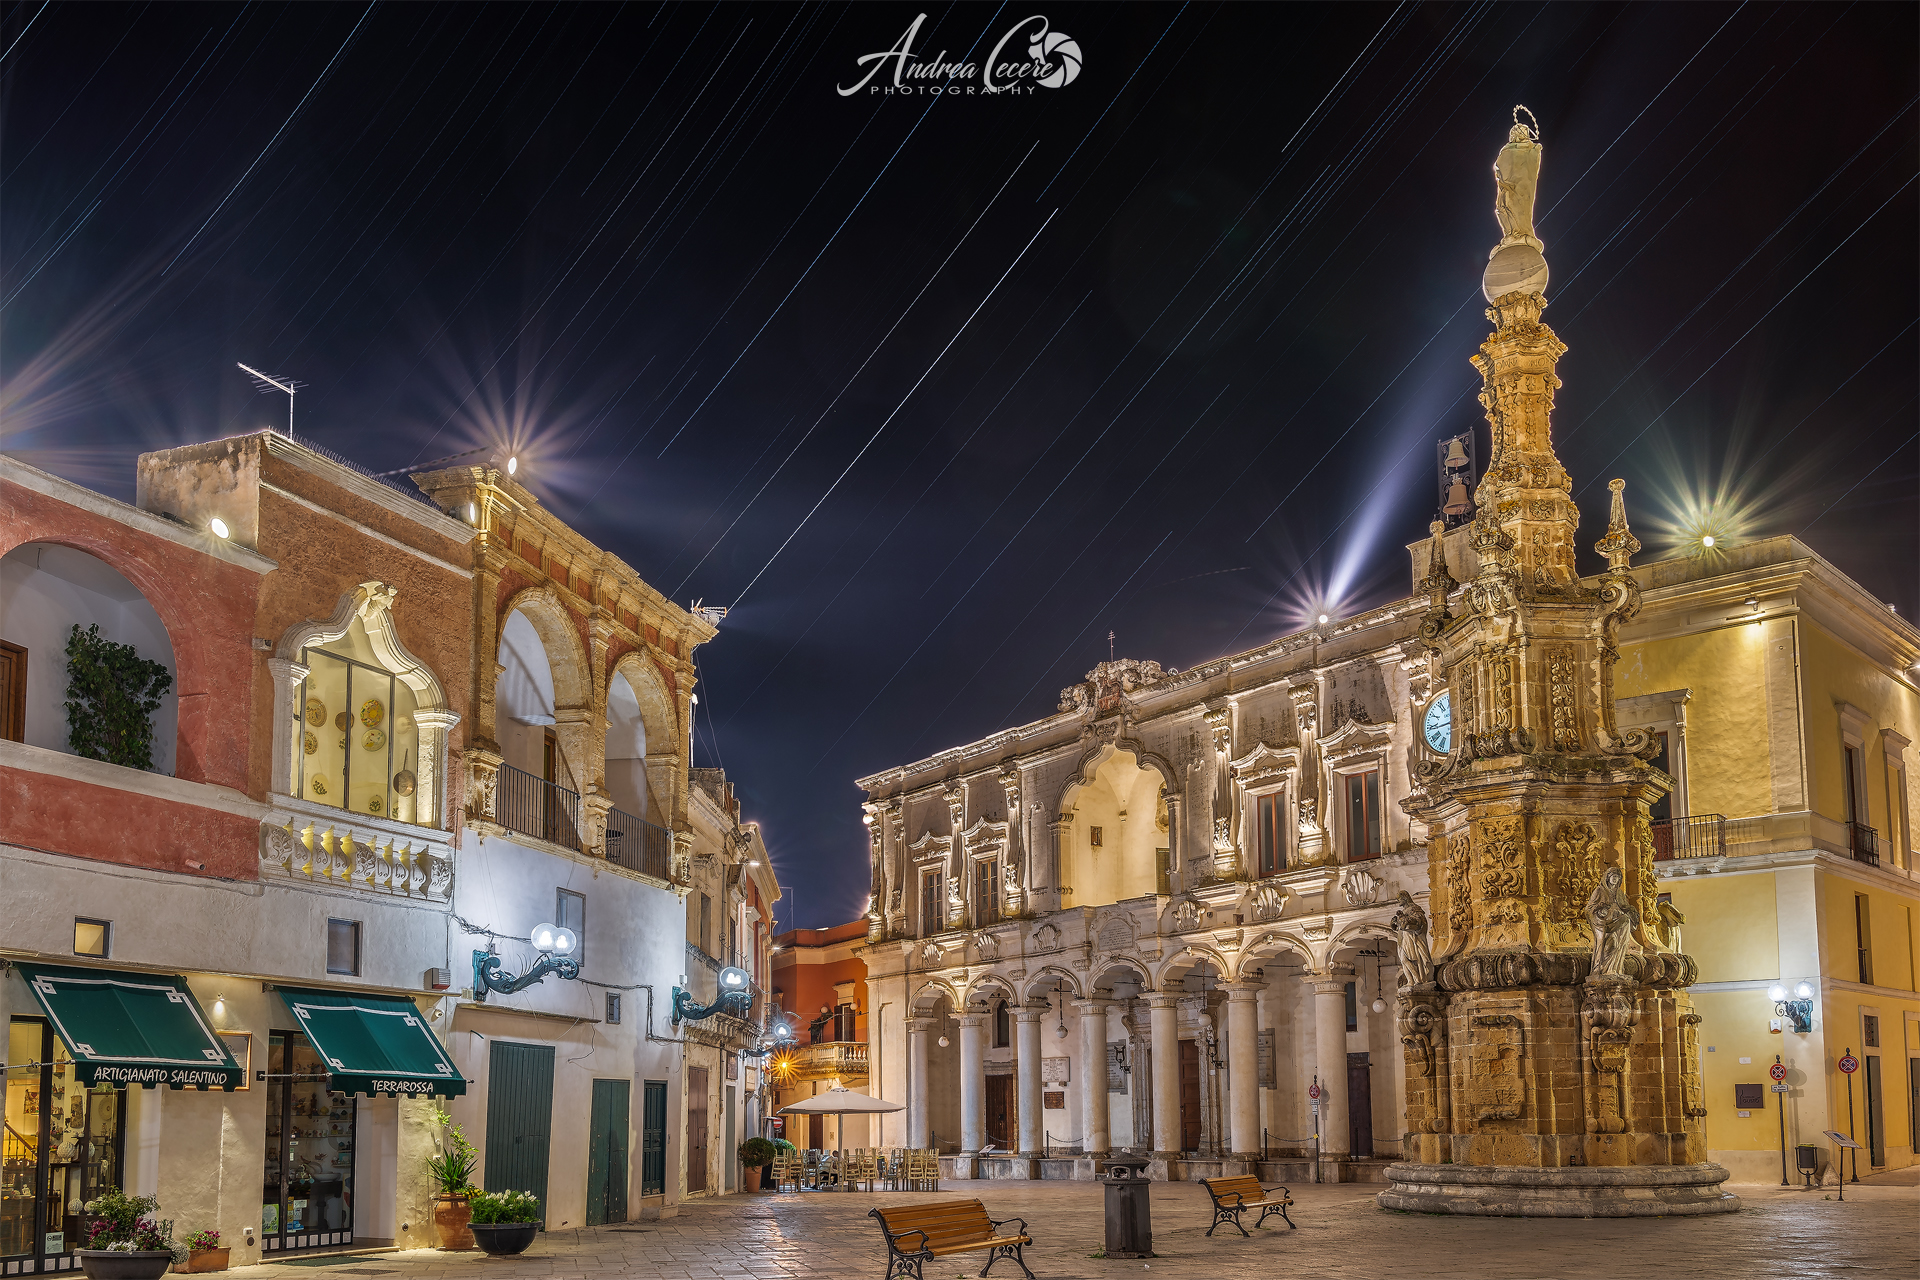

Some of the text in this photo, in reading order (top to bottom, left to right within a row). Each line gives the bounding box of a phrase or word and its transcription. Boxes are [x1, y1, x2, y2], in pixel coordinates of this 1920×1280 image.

[94, 1066, 228, 1085] ARTIGIANATO SALENTINO
[371, 1080, 434, 1093] TERRAROSSA
